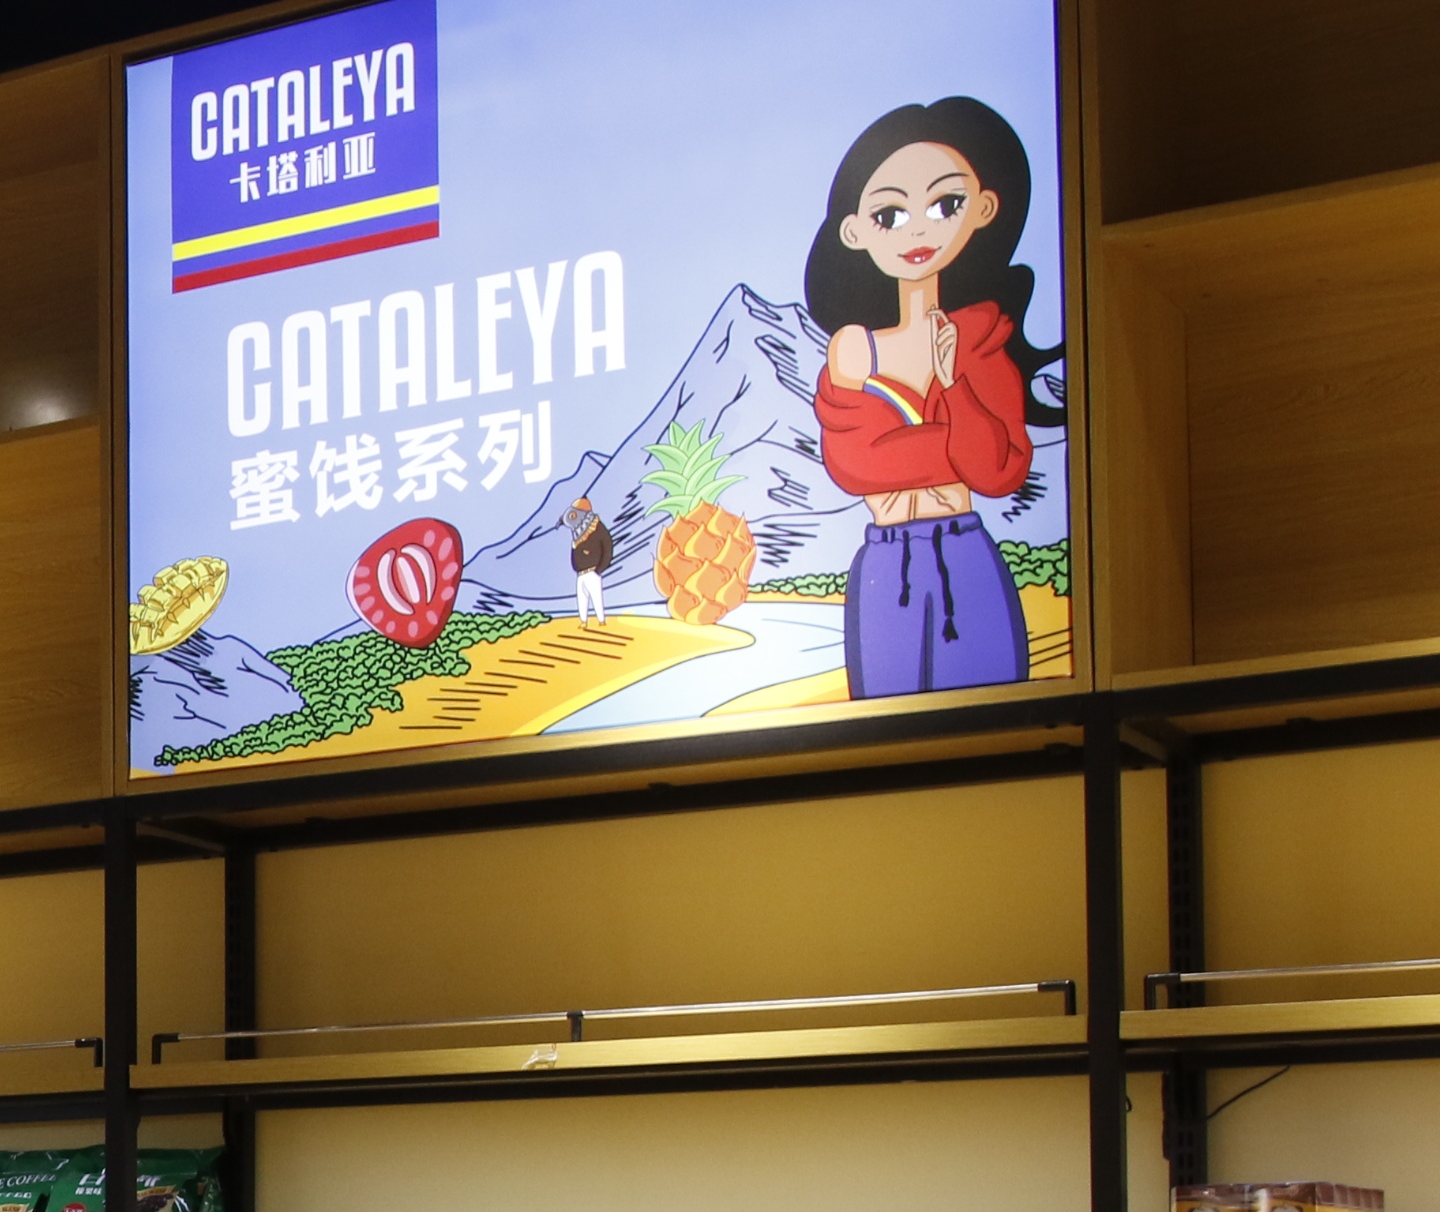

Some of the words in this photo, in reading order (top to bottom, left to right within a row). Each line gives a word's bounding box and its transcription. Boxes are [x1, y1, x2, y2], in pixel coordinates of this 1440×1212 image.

[190, 41, 415, 162] CATALEYA
[229, 133, 377, 203] 卡塔利亚
[226, 249, 627, 437] CATALEYA
[227, 400, 553, 532] 蜜饯系列
